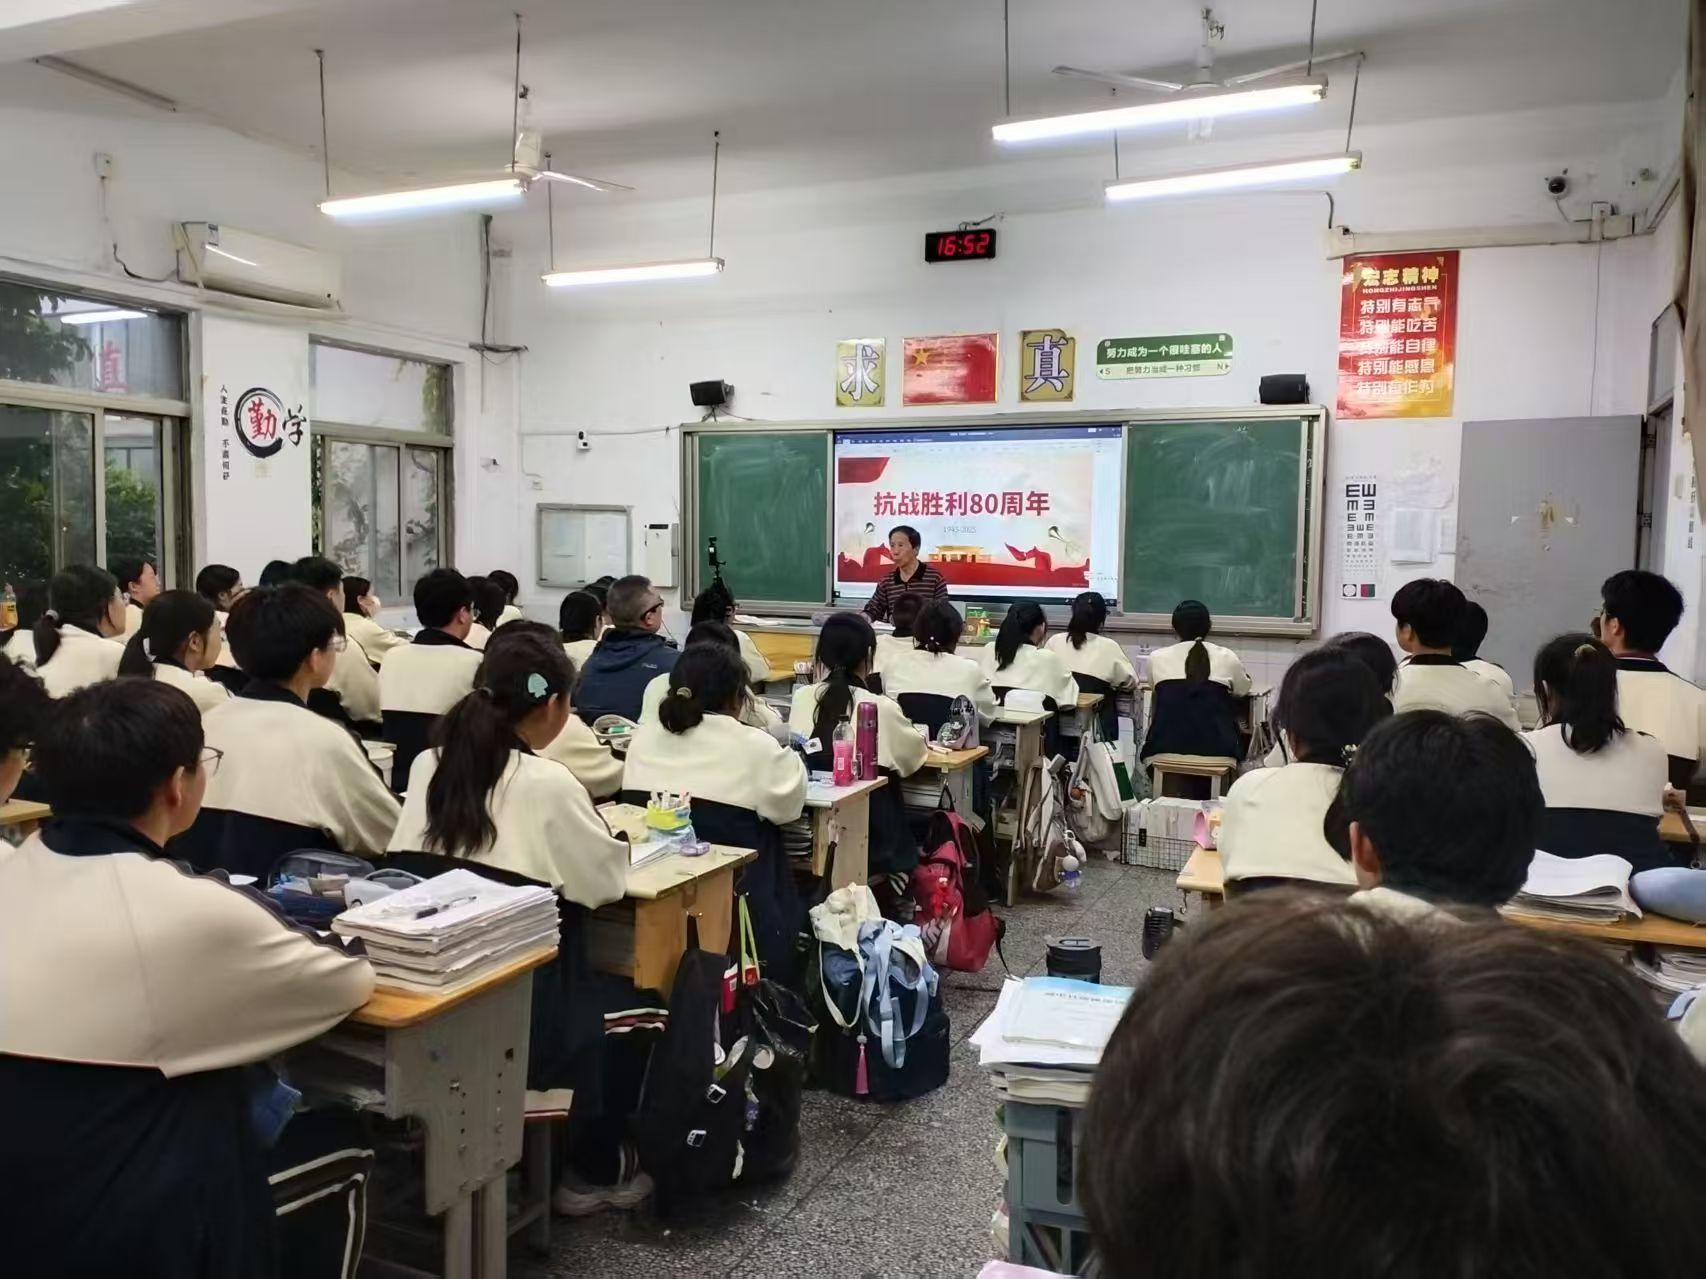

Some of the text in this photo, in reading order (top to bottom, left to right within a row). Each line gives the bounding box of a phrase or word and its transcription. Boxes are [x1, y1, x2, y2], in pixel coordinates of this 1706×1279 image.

[937, 233, 990, 256] 16:52
[1361, 266, 1440, 286] 宏志精神
[1359, 316, 1437, 335] 特别能吃苦
[840, 343, 881, 401] 求
[1024, 335, 1068, 393] 真
[1358, 359, 1435, 375] 特别能感恩
[873, 490, 1050, 517] 抗战胜利80周年
